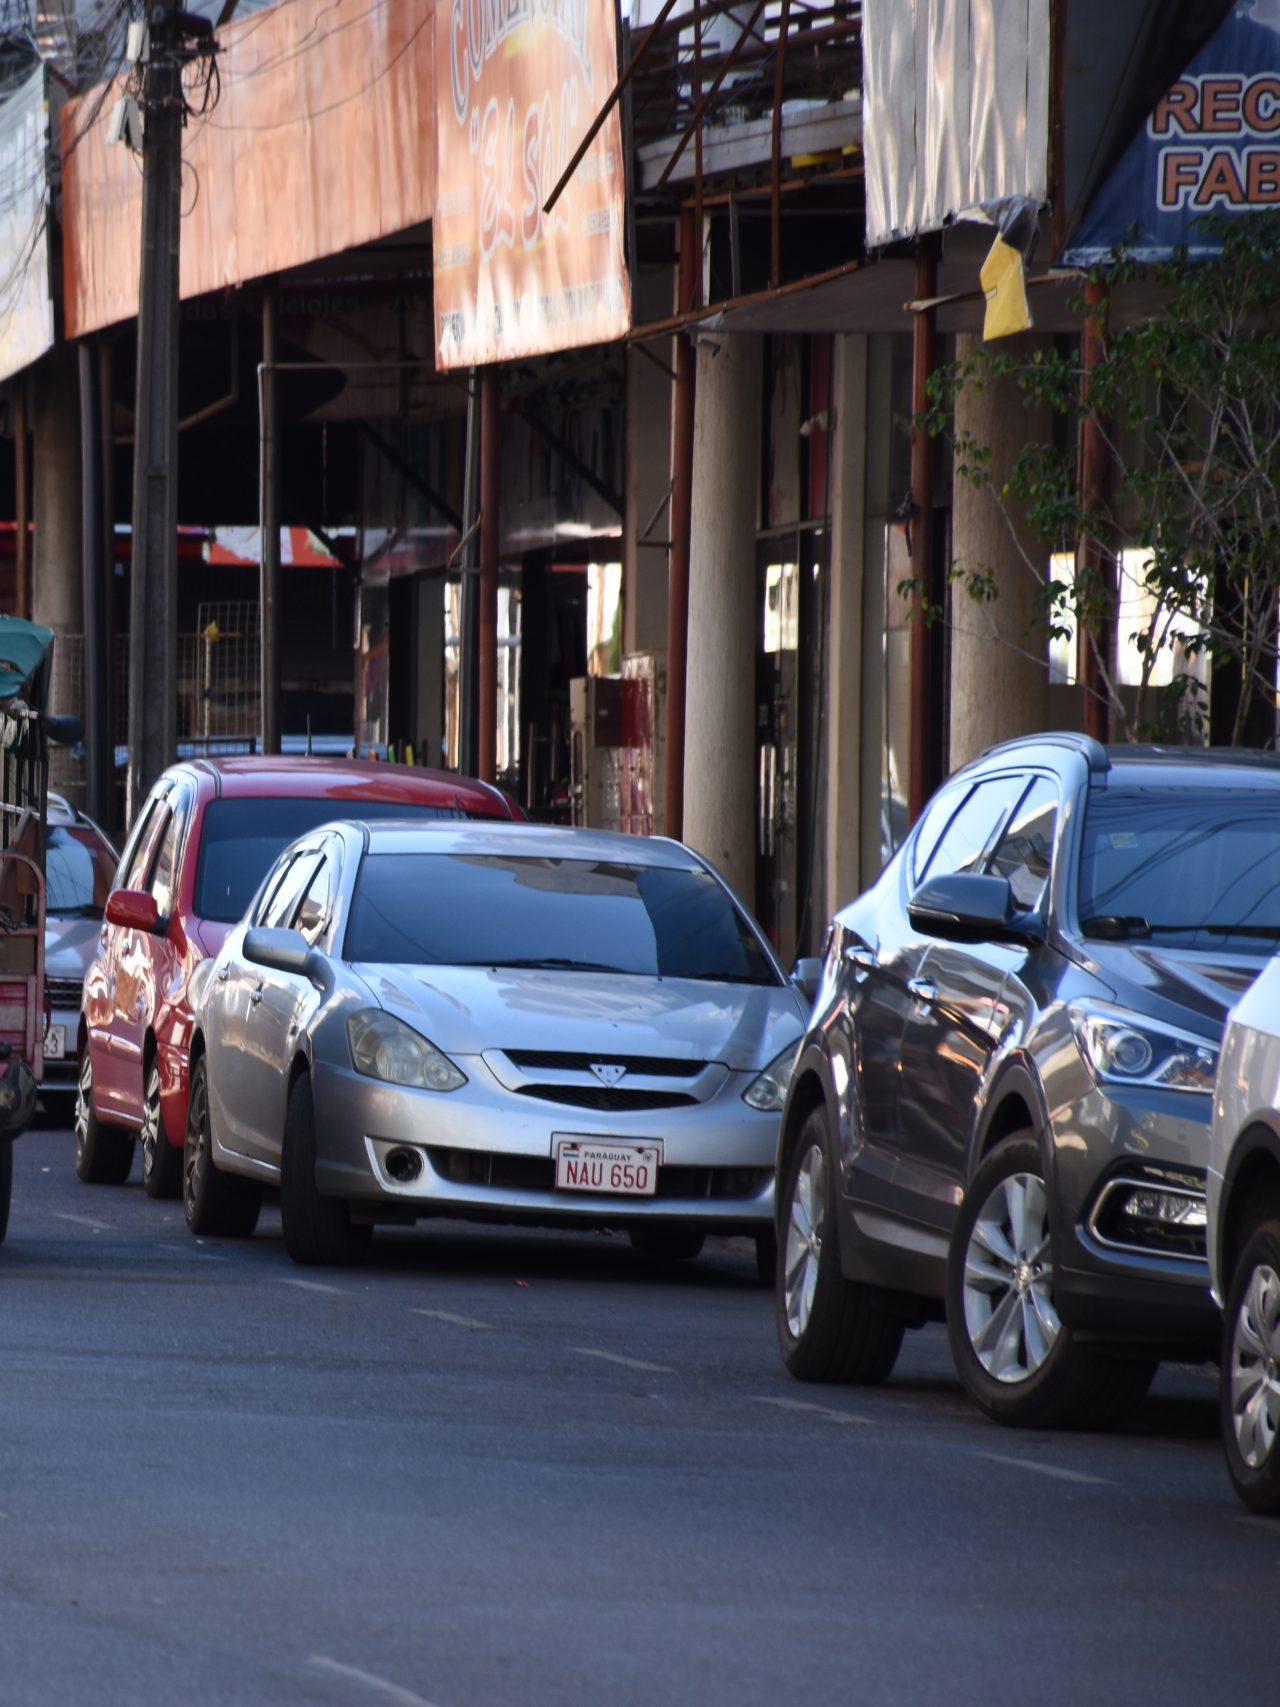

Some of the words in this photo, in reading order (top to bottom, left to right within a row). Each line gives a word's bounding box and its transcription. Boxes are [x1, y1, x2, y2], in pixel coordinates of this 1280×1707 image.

[1147, 72, 1280, 139] REC
[1156, 145, 1280, 211] FAB
[566, 1160, 603, 1187] NAU
[610, 1163, 648, 1190] 650
[584, 1151, 631, 1162] PARAGUAY
